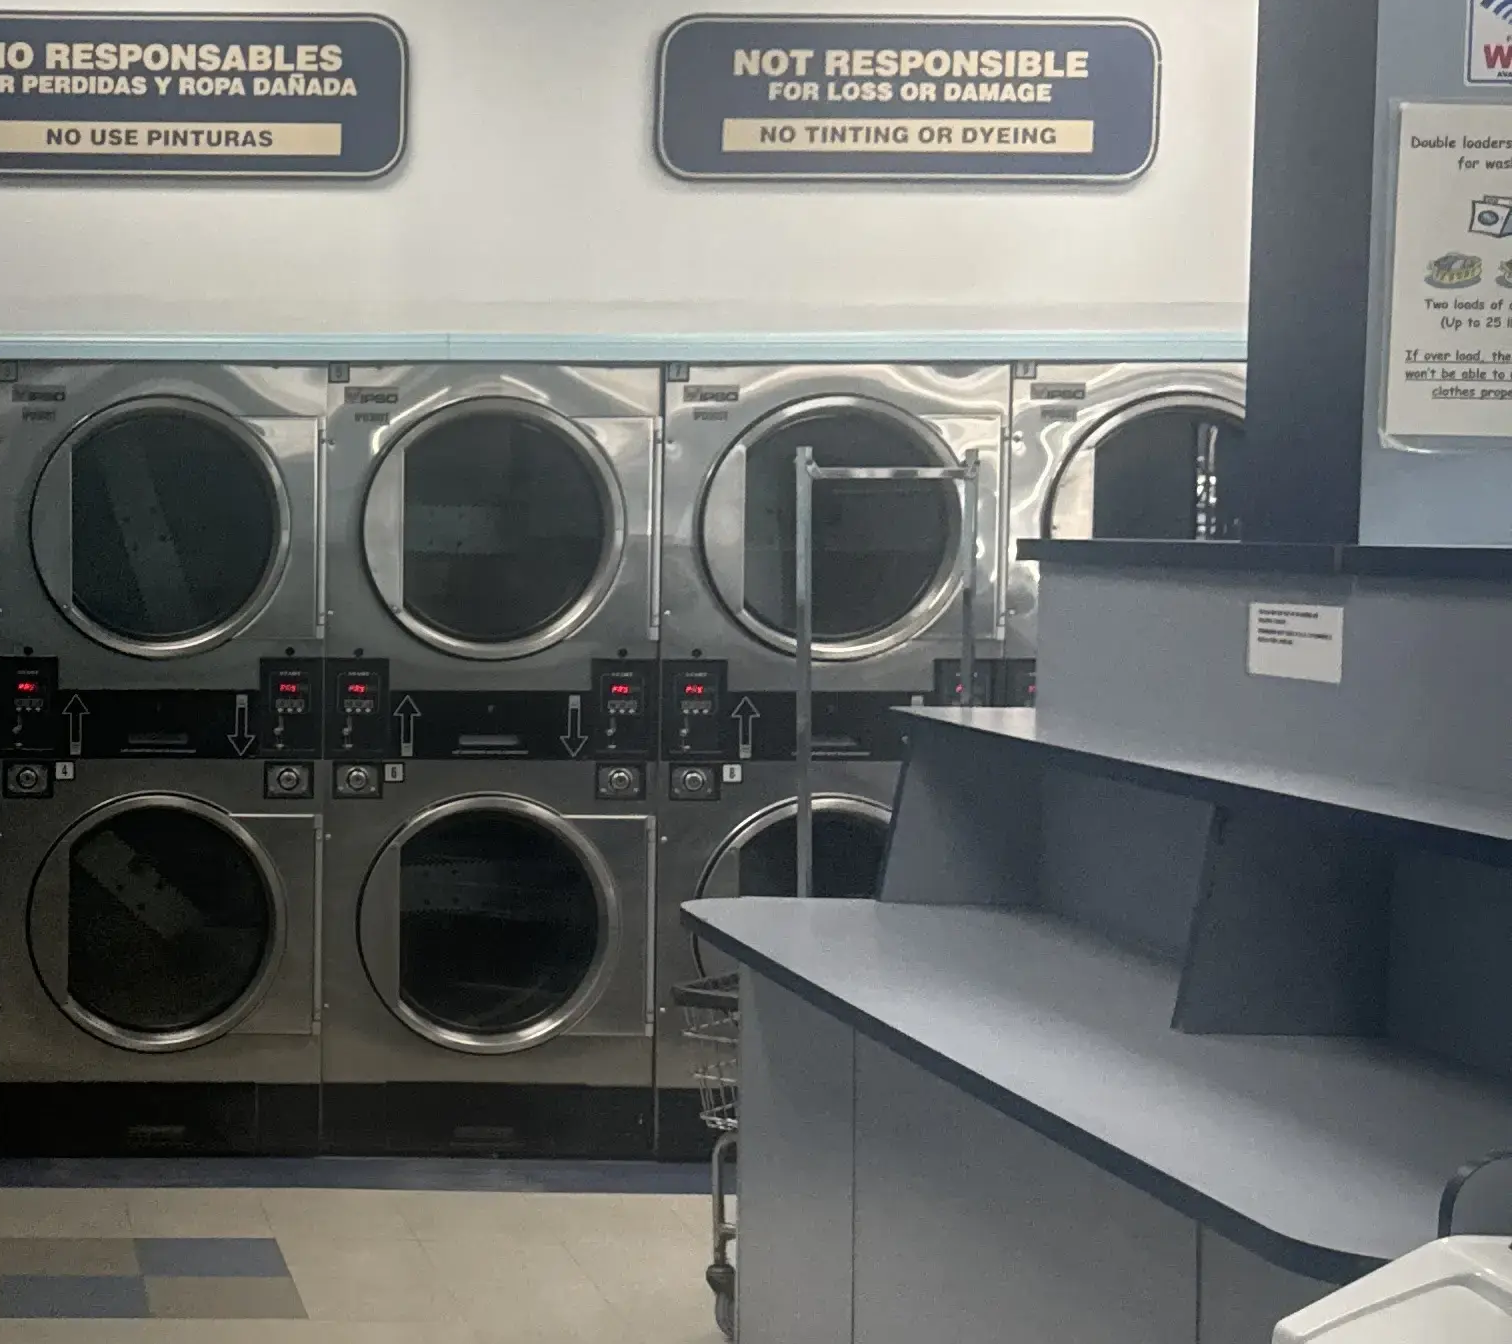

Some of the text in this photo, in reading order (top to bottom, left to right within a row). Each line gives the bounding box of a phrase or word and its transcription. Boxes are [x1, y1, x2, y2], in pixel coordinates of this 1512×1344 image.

[45, 42, 344, 73] RESPONSABLES
[734, 48, 1090, 78] NOT RESPONSIBLE
[22, 75, 148, 96] PERDIDAS
[153, 76, 173, 96] Y
[178, 76, 247, 97] ROPA
[252, 73, 359, 97] DAÑADA
[768, 81, 1053, 103] FOR LOSS OR DAMAGE
[45, 128, 274, 148] NO USE PINTURAS
[759, 124, 1058, 145] NO TINTING OR DYEING
[1411, 135, 1512, 149] Double loaders
[1457, 155, 1480, 170] for
[1424, 298, 1448, 310] Two
[1454, 297, 1484, 310] loads
[1490, 298, 1504, 310] of
[1440, 316, 1462, 332] (Up
[1468, 317, 1481, 328] to
[1486, 316, 1502, 329] 25
[1405, 348, 1512, 364] If over load, the
[1405, 367, 1436, 379] won't
[1441, 367, 1455, 379] be
[1461, 367, 1487, 379] able
[1492, 367, 1505, 379] to
[360, 393, 398, 404] IPSO
[699, 391, 739, 402] IPSO
[1431, 385, 1476, 397] clothes
